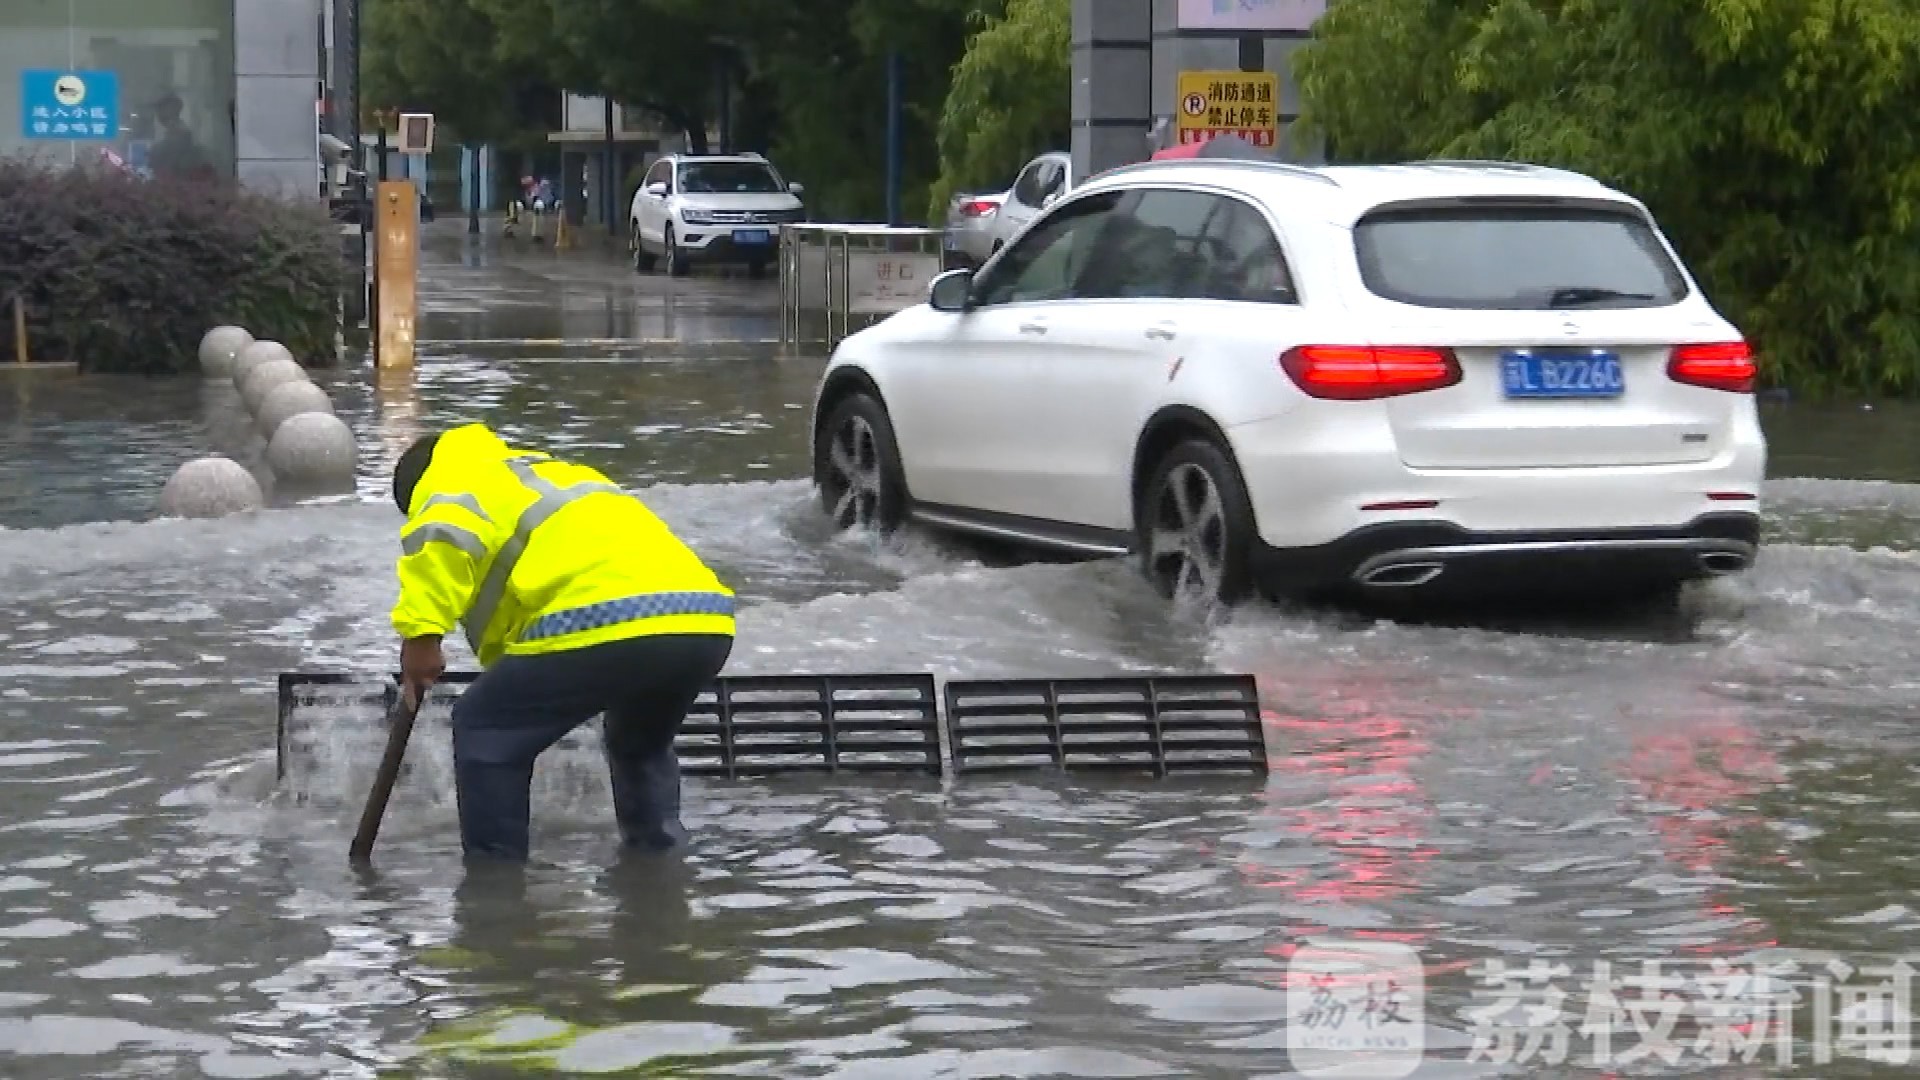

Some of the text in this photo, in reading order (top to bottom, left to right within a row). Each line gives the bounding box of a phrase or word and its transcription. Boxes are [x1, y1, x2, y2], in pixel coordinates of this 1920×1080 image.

[1208, 81, 1271, 103] 消防通道
[1208, 106, 1271, 127] 禁止停车
